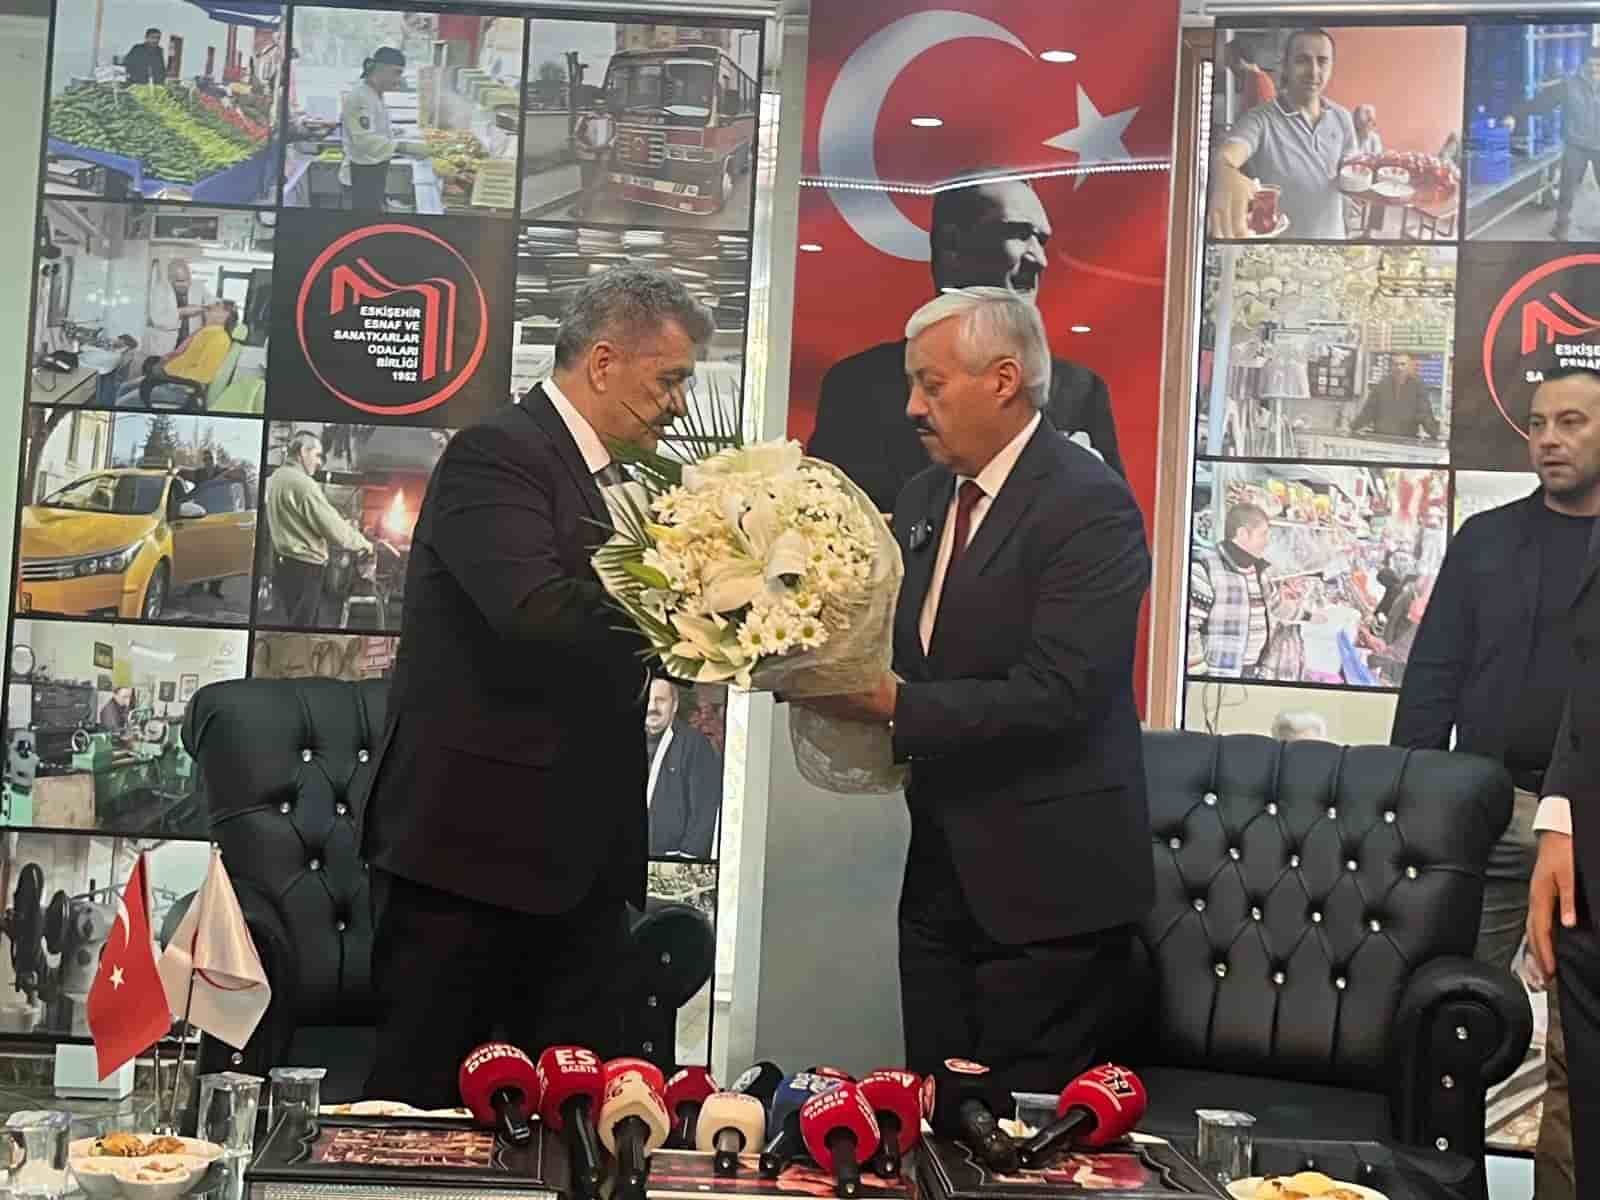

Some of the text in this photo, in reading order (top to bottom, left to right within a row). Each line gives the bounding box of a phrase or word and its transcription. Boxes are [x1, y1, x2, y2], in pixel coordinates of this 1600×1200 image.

[360, 305, 421, 318] ESKİŞEHİR
[364, 319, 420, 331] ESNAF VE
[333, 330, 419, 342] SANATKARLAR
[368, 345, 418, 355] ODALARI
[376, 356, 418, 368] BİRLİĞİ
[554, 1049, 597, 1066] ES
